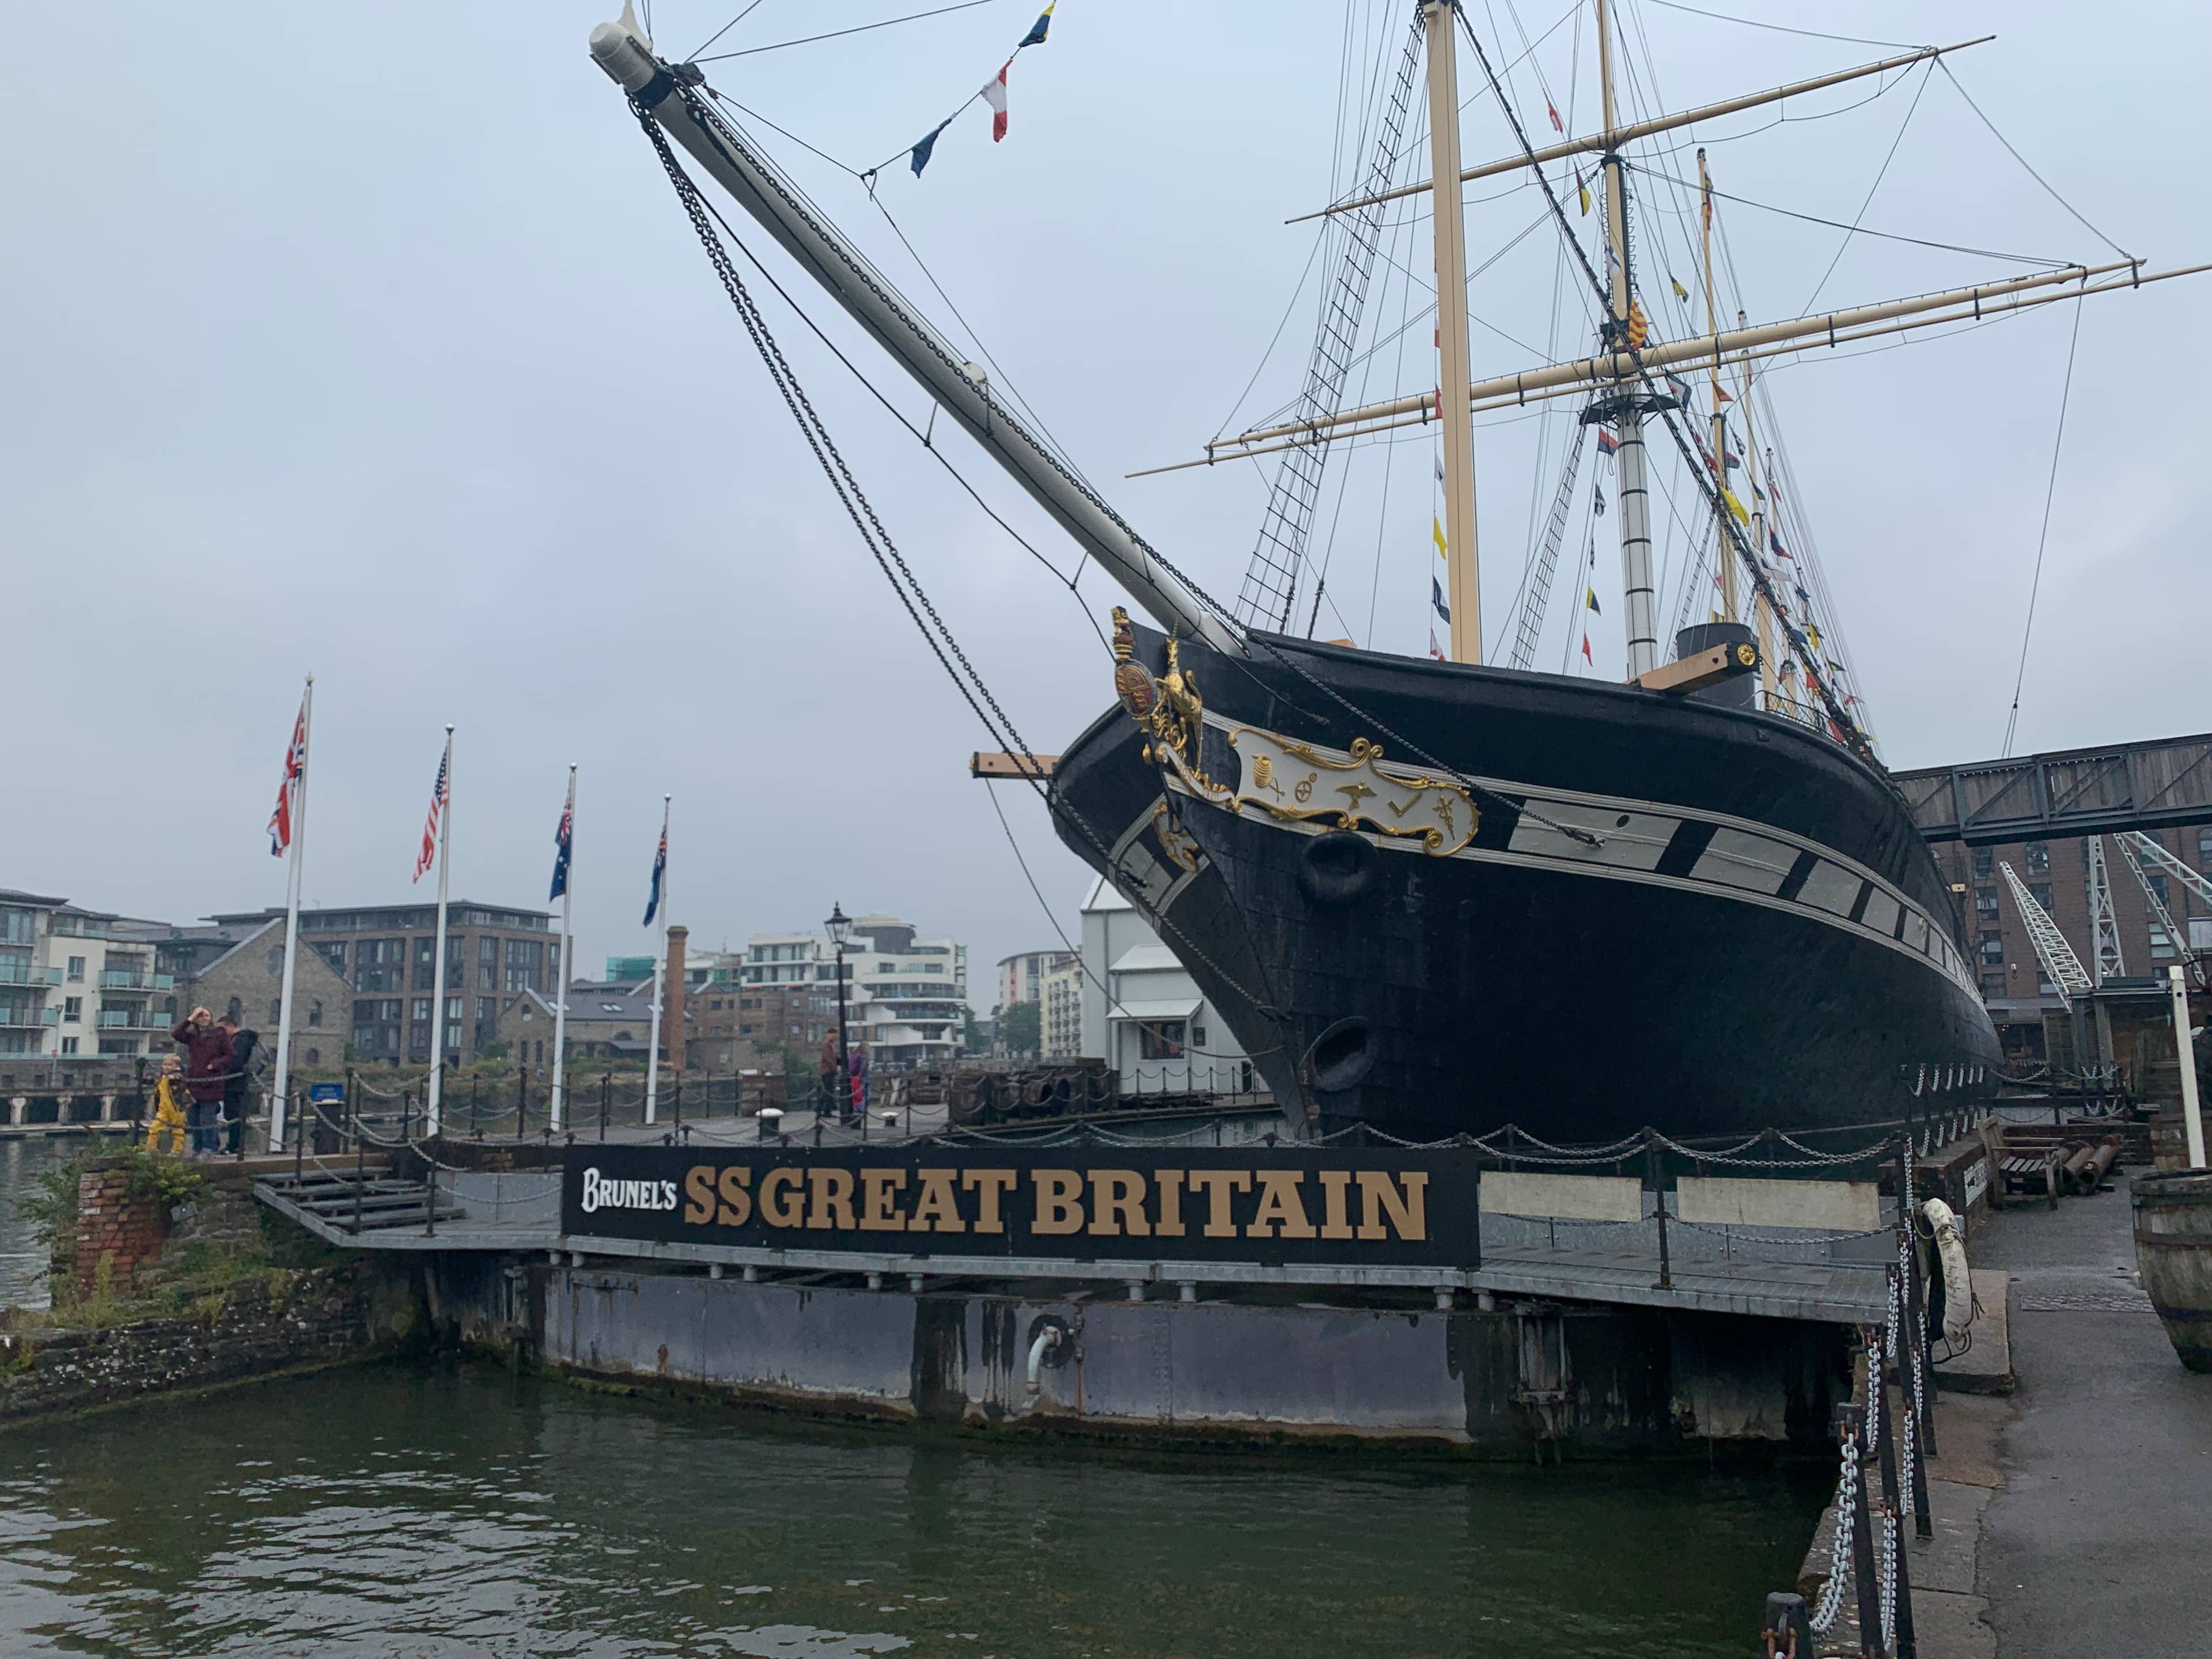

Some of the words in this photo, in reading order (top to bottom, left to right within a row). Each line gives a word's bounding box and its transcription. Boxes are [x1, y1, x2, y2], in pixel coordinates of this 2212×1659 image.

[581, 1167, 677, 1213] BRUNEL'S
[684, 1165, 752, 1227] SS
[759, 1166, 1017, 1234] GREAT
[1031, 1169, 1429, 1241] BRITAIN
